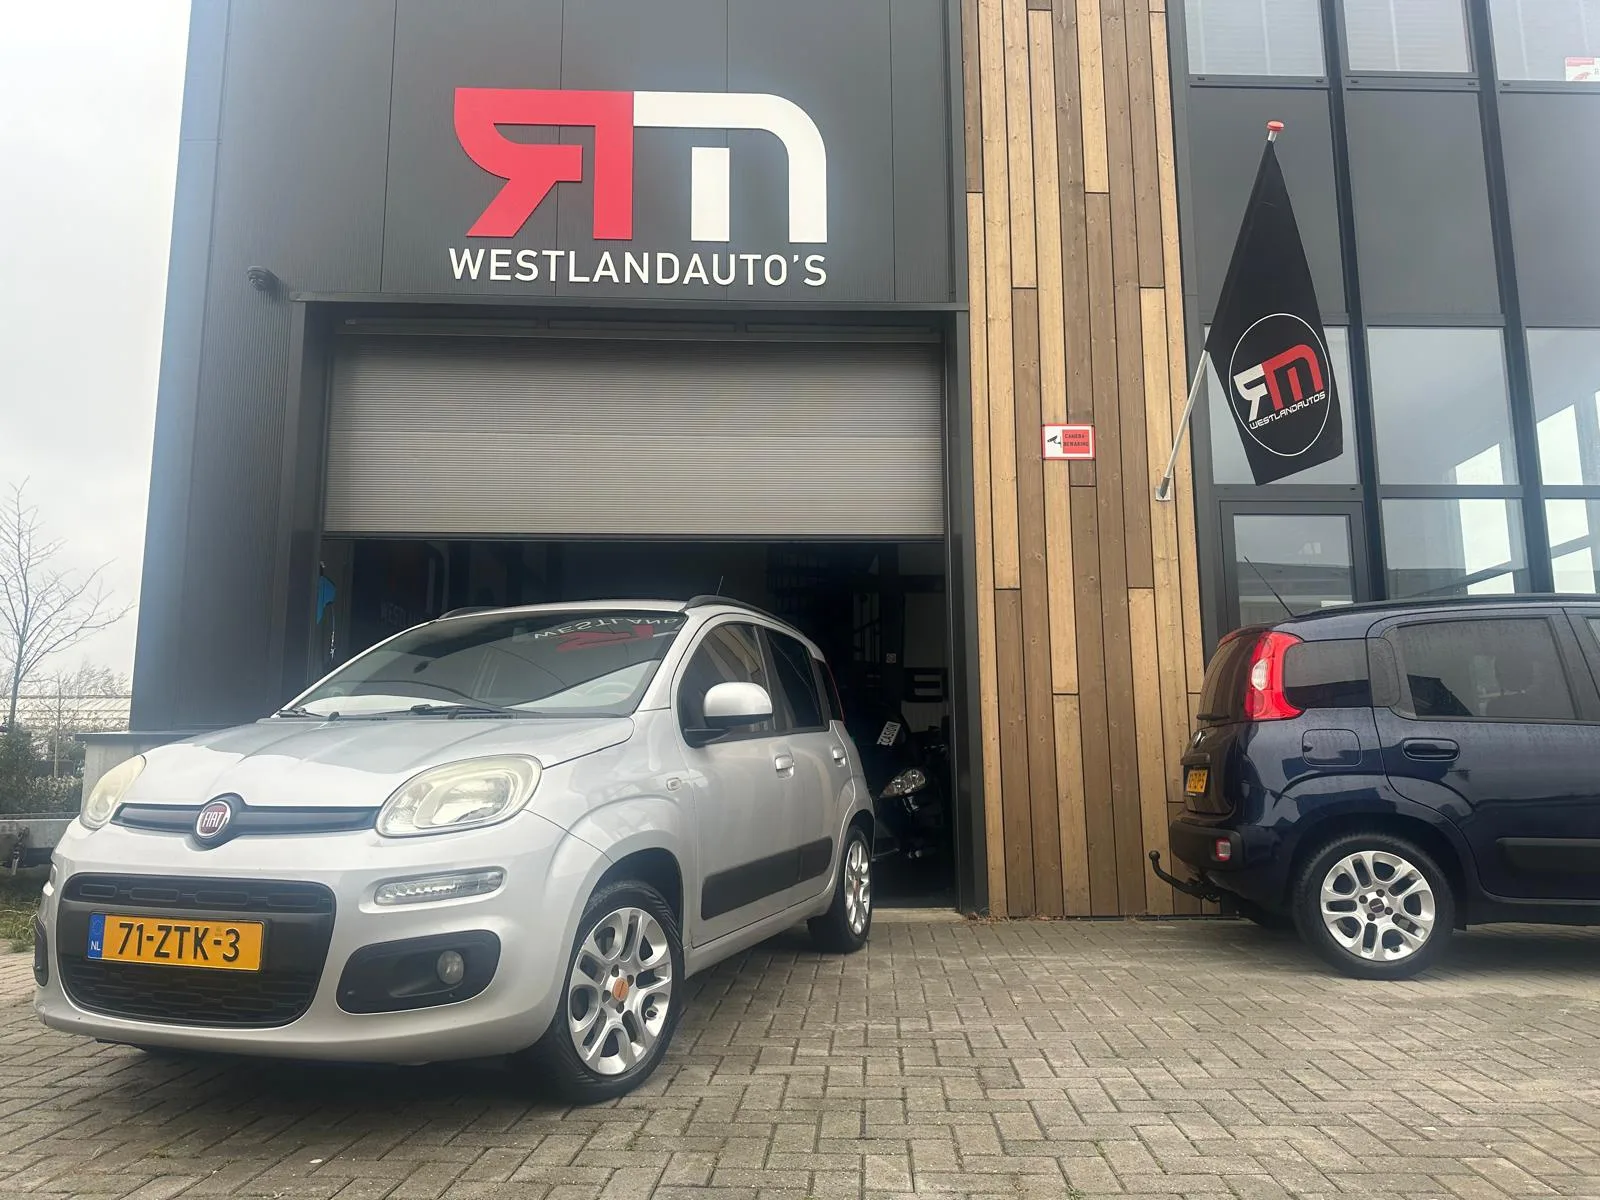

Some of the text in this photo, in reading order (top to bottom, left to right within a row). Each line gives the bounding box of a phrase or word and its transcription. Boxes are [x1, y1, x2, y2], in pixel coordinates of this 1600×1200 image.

[449, 247, 827, 286] WESTLANDAUTO'S
[1249, 391, 1326, 430] WESTLANDAUTOS
[201, 811, 224, 828] FIAT
[90, 940, 101, 951] NL
[118, 922, 241, 963] 71-ZTK-3
